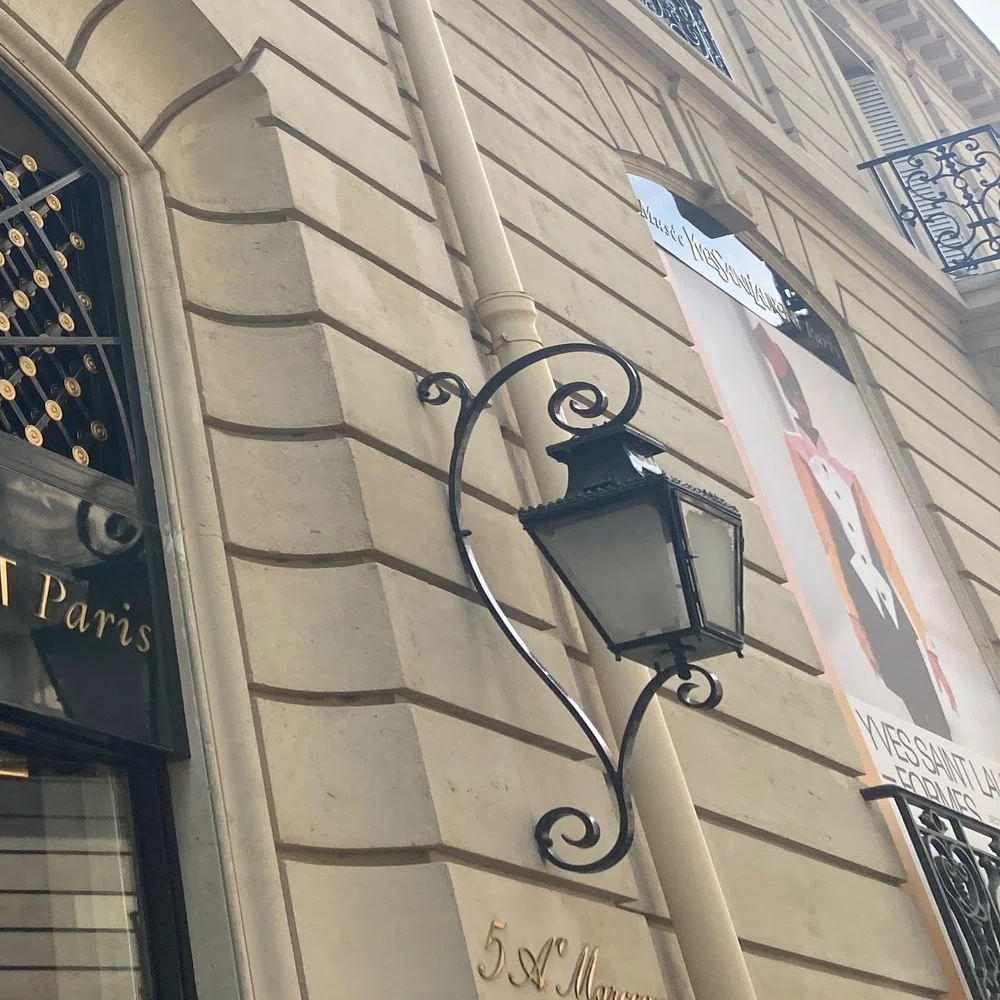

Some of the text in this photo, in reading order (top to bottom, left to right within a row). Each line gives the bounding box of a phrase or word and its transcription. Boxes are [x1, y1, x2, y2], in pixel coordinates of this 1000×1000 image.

[34, 571, 151, 653] Paris
[855, 709, 919, 768] YVES
[913, 736, 975, 791] SAINT
[477, 919, 508, 981] 5
